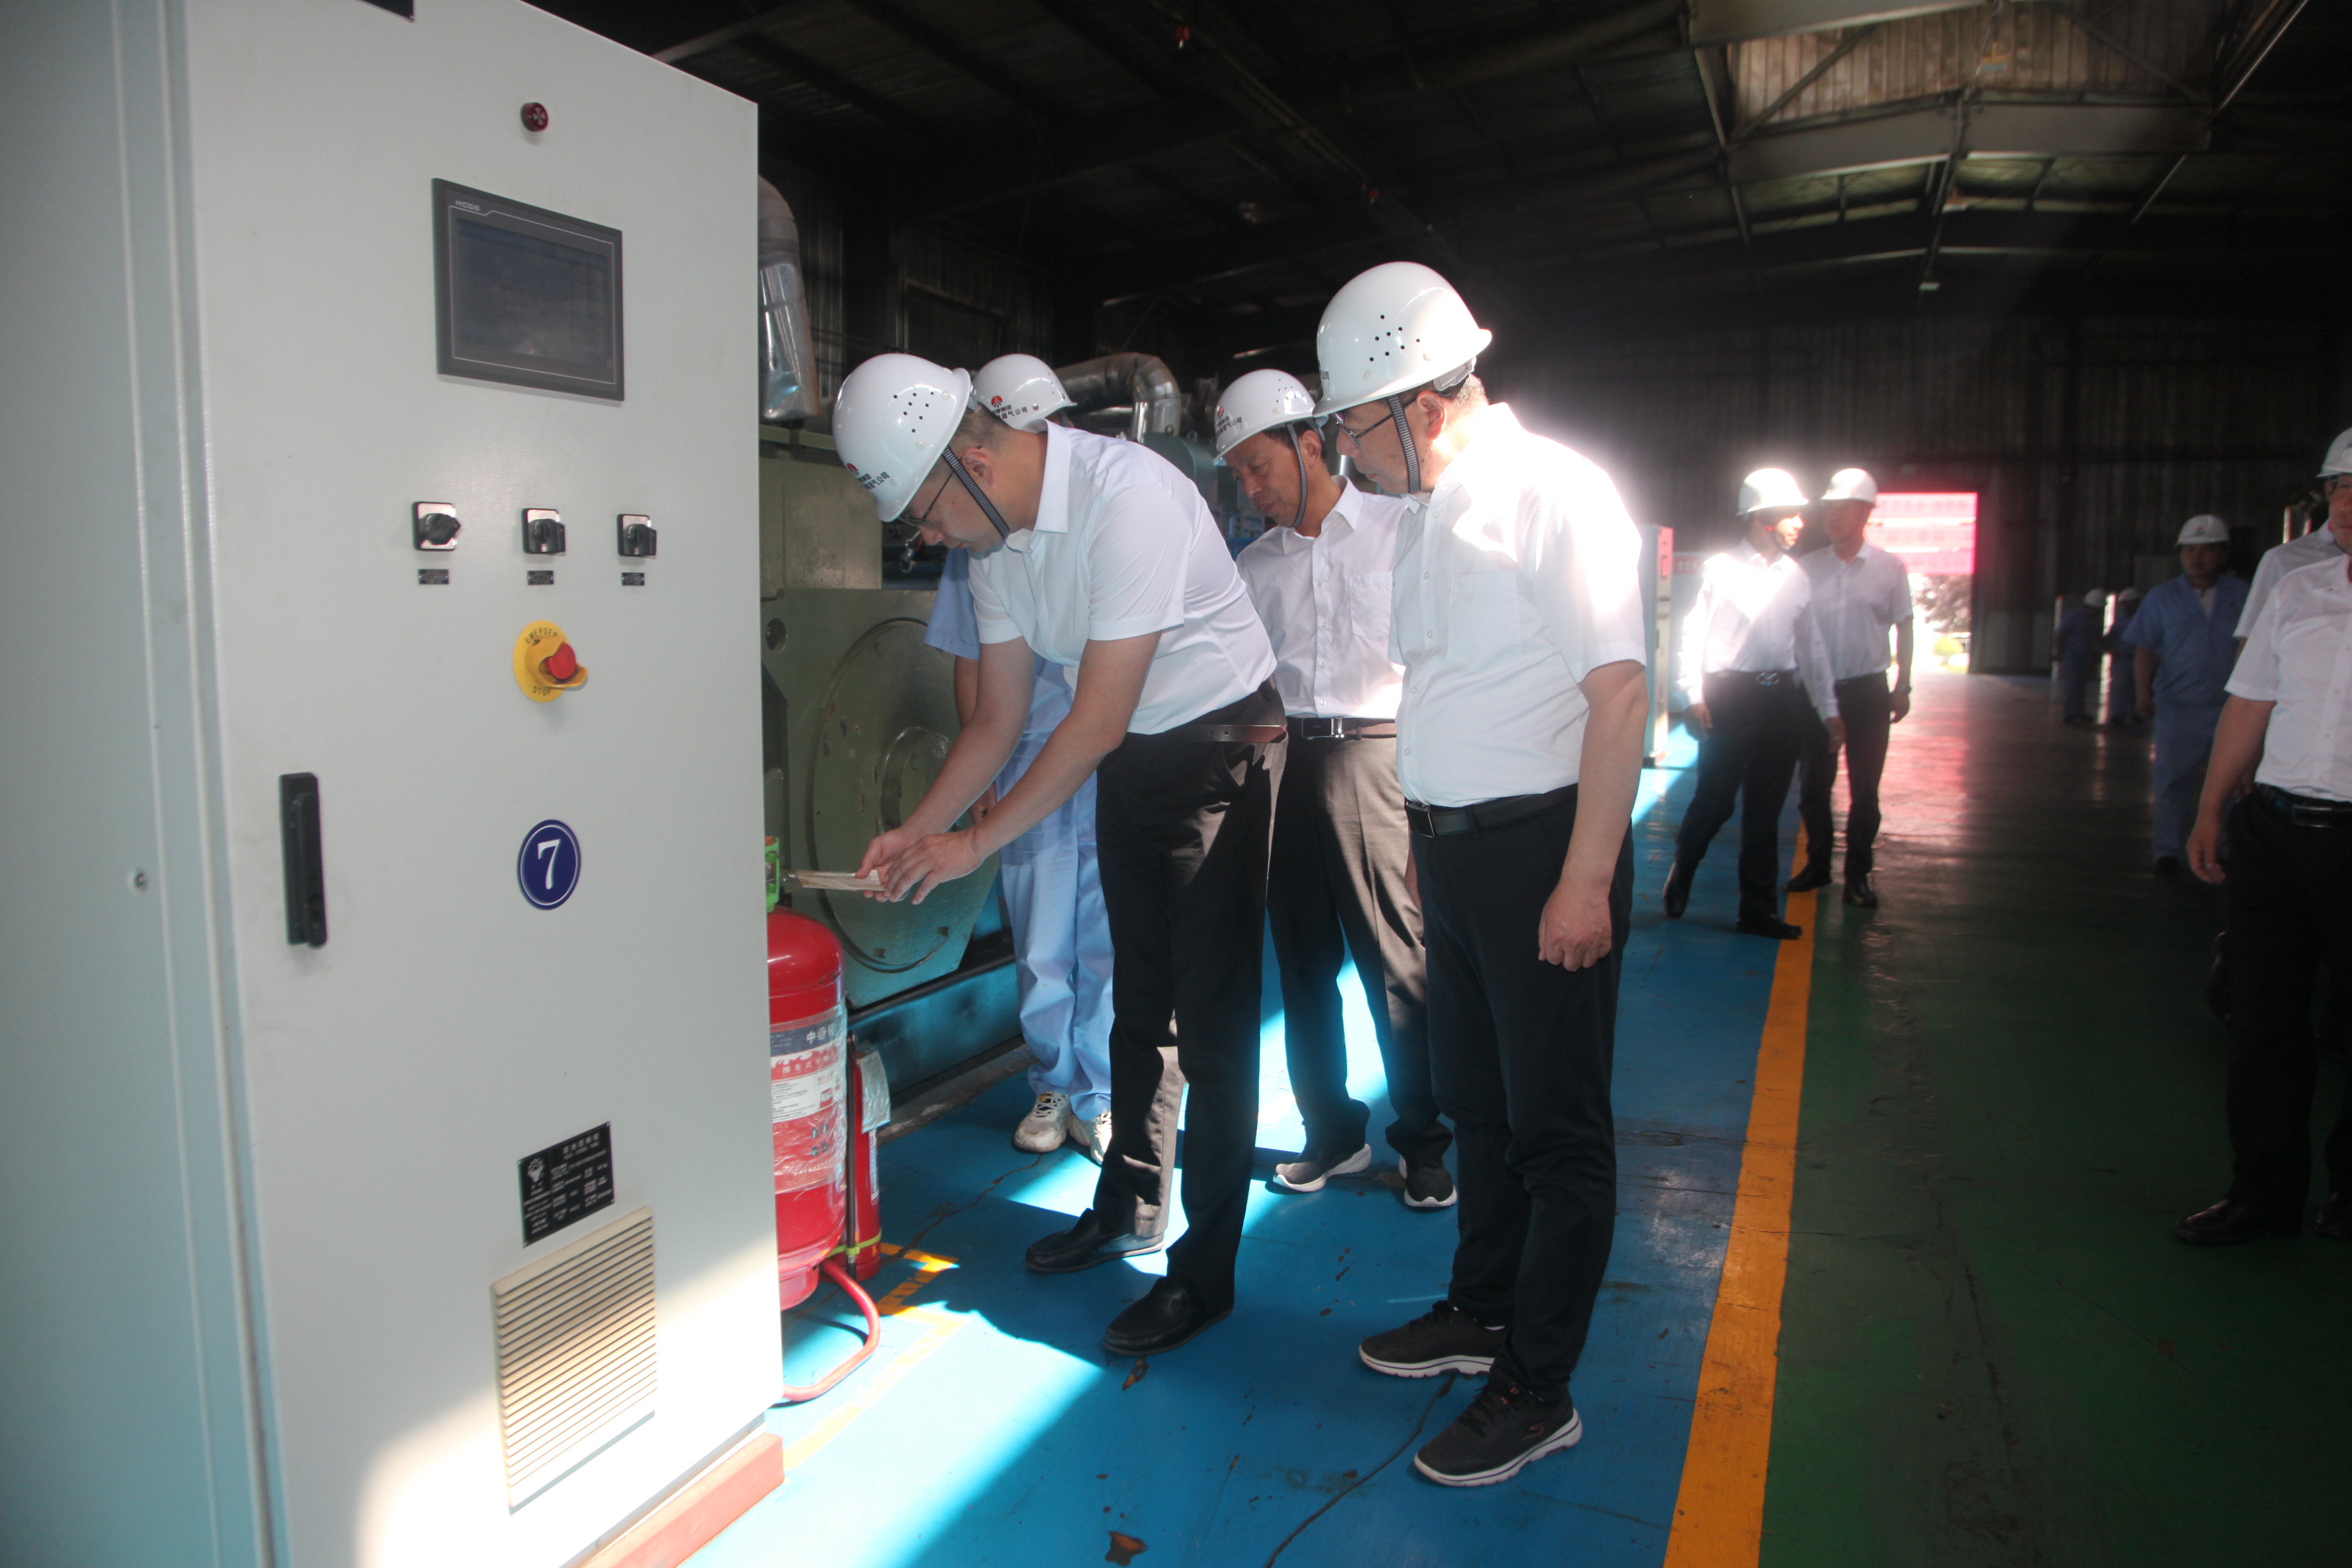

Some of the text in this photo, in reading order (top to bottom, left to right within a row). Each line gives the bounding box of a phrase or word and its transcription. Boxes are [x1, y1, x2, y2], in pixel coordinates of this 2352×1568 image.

[455, 200, 480, 212] MCGS
[525, 627, 557, 644] EMERGEN
[532, 685, 551, 696] STOP
[538, 838, 561, 889] 7
